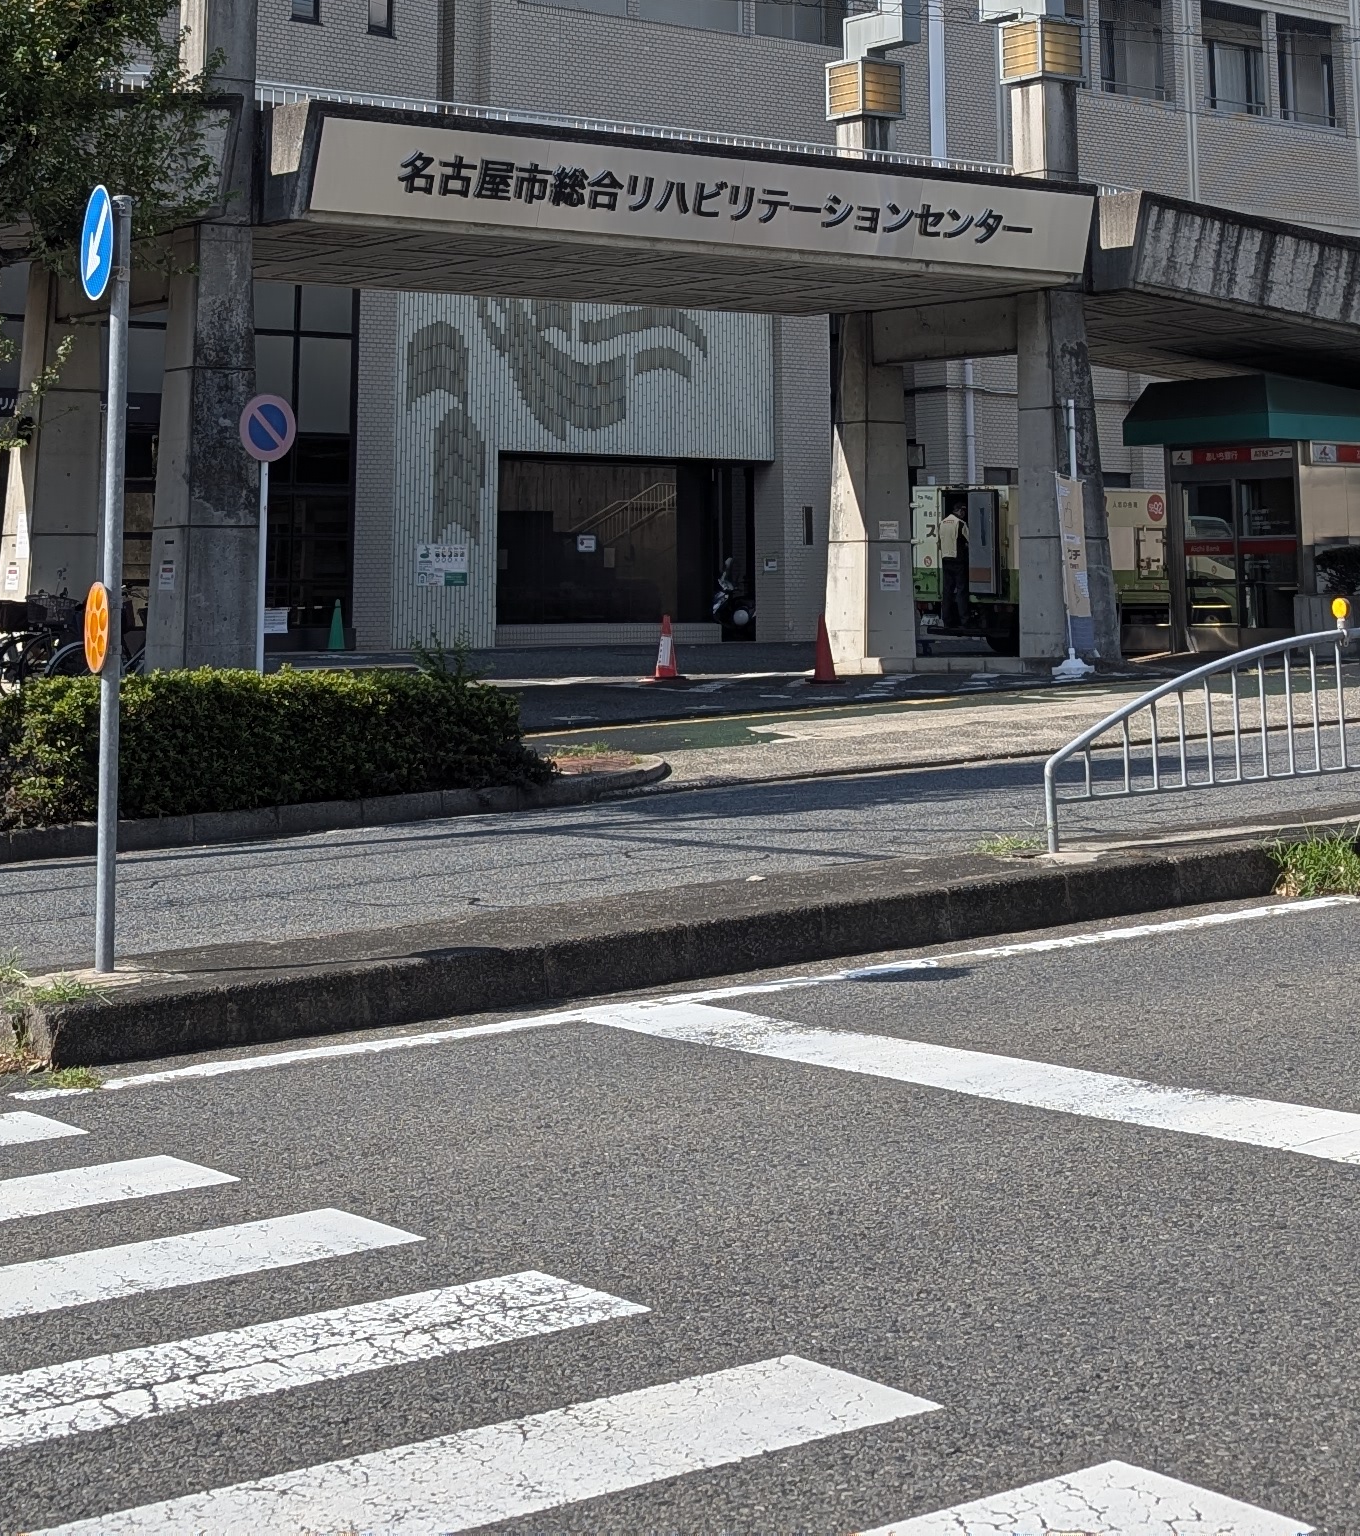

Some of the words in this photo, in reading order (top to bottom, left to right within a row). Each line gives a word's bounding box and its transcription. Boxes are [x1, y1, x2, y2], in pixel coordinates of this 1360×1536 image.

[398, 151, 1033, 244] 名古屋市総合リハビリテーションセンター
[1205, 450, 1239, 462] あいち銀行
